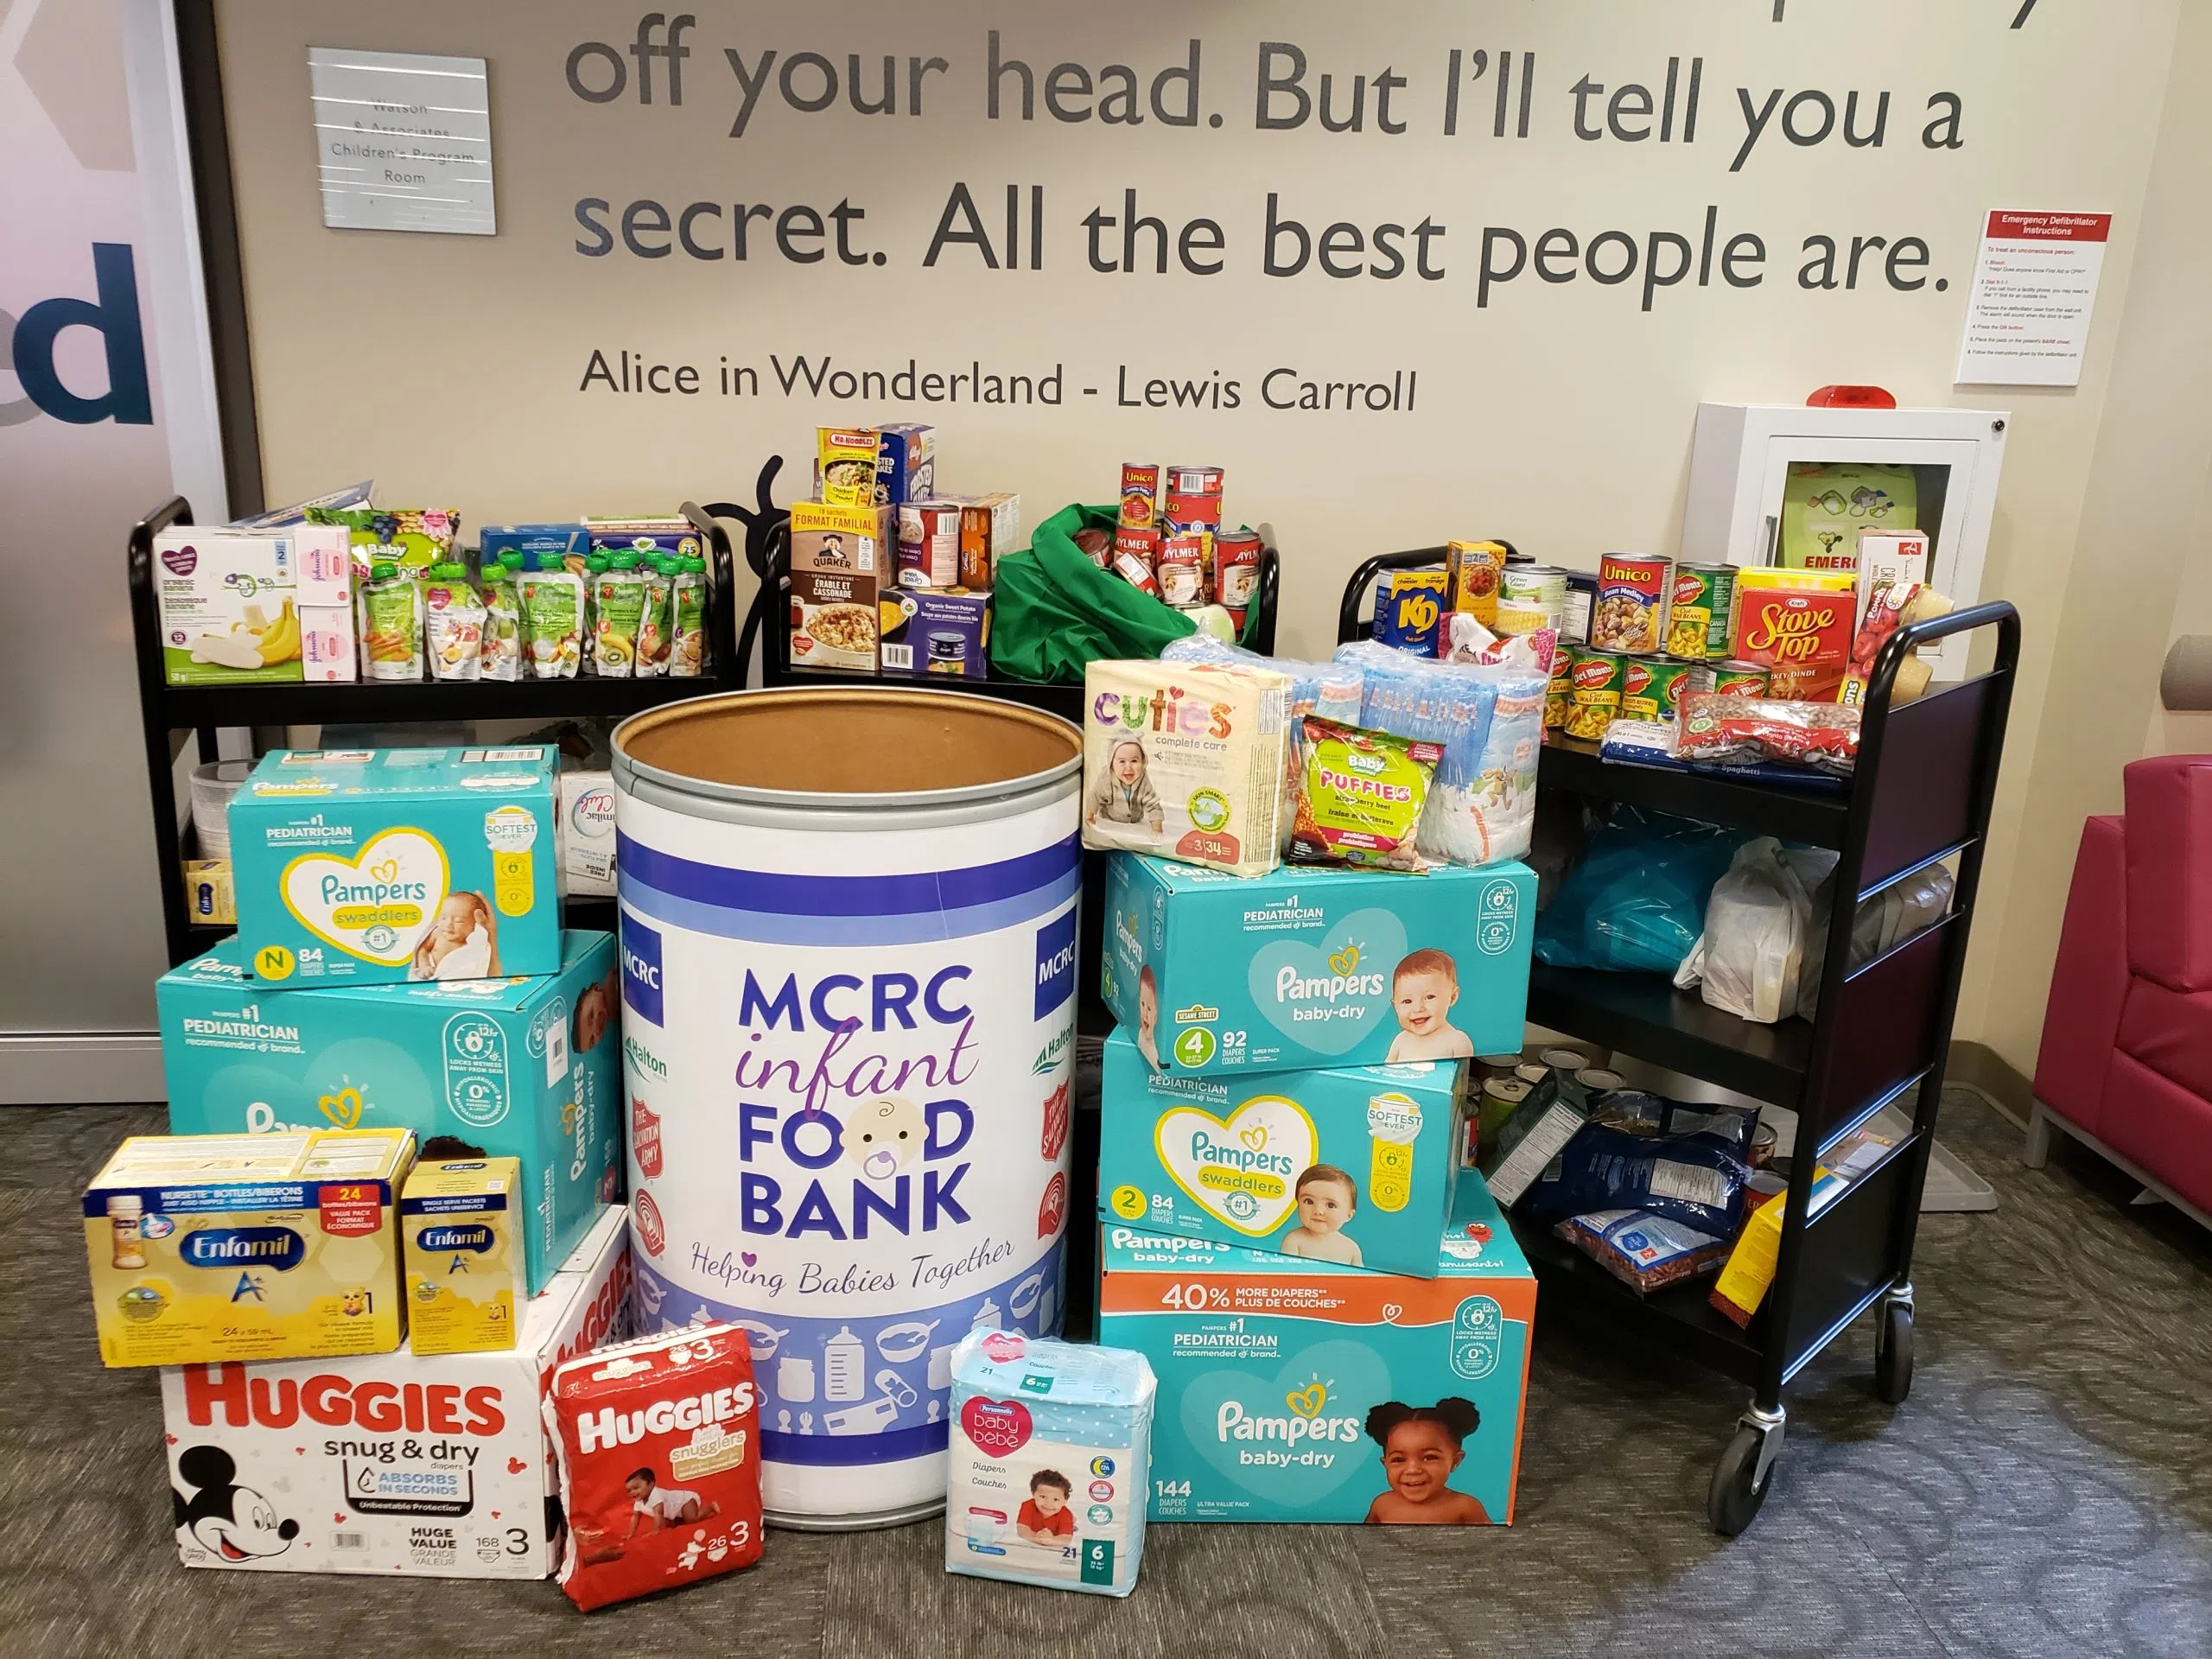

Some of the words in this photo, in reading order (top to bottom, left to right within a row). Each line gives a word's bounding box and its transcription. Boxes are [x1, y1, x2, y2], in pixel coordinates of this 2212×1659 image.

[565, 13, 696, 107] off
[723, 48, 950, 138] your
[987, 29, 1224, 129] head.
[1256, 41, 1408, 135] But
[1444, 48, 1535, 138] I'll
[1568, 57, 1702, 144] tell
[1729, 87, 1890, 172] you
[1923, 91, 1964, 149] a
[332, 143, 406, 159] Children's
[412, 148, 475, 166] Program
[385, 169, 426, 184] Room
[2001, 214, 2049, 226] Emergency
[2050, 216, 2098, 226] Defibrillator
[2023, 226, 2072, 236] Instructions
[574, 195, 887, 267] secret.
[922, 182, 1044, 270] All
[1080, 188, 1226, 276] the
[1263, 193, 1446, 281] best
[1478, 206, 1766, 311] people
[1798, 232, 1949, 292] are.
[579, 349, 700, 395] Alice
[720, 357, 759, 397] in
[770, 355, 1062, 406] Wonderland
[1117, 365, 1242, 410] Lewis
[1261, 367, 1418, 412] Carroll
[846, 436, 873, 445] NOODLES
[1127, 473, 1154, 483] Unico
[795, 514, 830, 526] FORMAT
[833, 518, 873, 530] FAMILIAL
[367, 543, 408, 556] Baby
[1116, 537, 1149, 550] AYLMER
[1162, 547, 1199, 560] AYLMER
[813, 557, 851, 569] QUAKER
[1605, 564, 1651, 582] Unico
[815, 579, 840, 588] ÉRABLE
[813, 588, 852, 598] CASSONADE
[1605, 587, 1619, 598] Bean
[1620, 588, 1644, 602] Medley
[1398, 594, 1439, 634] KD
[1746, 603, 1836, 649] Stove
[1398, 646, 1430, 656] ORIGINAL
[1772, 634, 1820, 663] Top
[1574, 673, 1585, 683] Del
[1586, 665, 1613, 677] Monte
[1628, 672, 1649, 683] Monte
[1094, 686, 1234, 739] cuties
[1155, 736, 1200, 748] complete
[1203, 741, 1227, 751] care
[1348, 755, 1386, 772] Baby
[1721, 764, 1760, 776] Spaghetti
[1320, 769, 1412, 803] PUFFIES
[1328, 809, 1349, 817] fraise
[266, 827, 353, 837] PEDIATRICIAN
[486, 823, 536, 834] SOFTEST
[1342, 831, 1374, 842] probiotics
[1205, 840, 1221, 855] 34
[321, 874, 426, 906] Pampers
[1287, 894, 1299, 907] #1
[336, 908, 418, 924] swaddlers
[1243, 906, 1324, 922] PEDIATRICIAN
[1243, 921, 1292, 931] recommended
[265, 950, 283, 969] N
[298, 948, 323, 962] 84
[1039, 940, 1075, 984] MCRC
[623, 944, 659, 990] MCRC
[1276, 966, 1383, 1003] Pampers
[738, 964, 973, 1033] MCRC
[1198, 1010, 1216, 1019] STREET
[1294, 1005, 1365, 1022] baby-dry
[183, 1018, 300, 1041] PEDIATRICIAN
[185, 1038, 256, 1052] recommended
[1185, 1032, 1204, 1053] 4
[1223, 1031, 1247, 1048] 92
[632, 1037, 667, 1077] Halton
[1222, 1048, 1245, 1057] DIAPERS
[735, 1016, 979, 1122] infant
[1148, 1075, 1228, 1096] PEDIATRICIAN
[1148, 1087, 1196, 1100] recommended
[571, 1061, 584, 1182] Pampers
[635, 1108, 646, 1127] THE
[1369, 1109, 1421, 1126] SOFTEST
[1385, 1122, 1405, 1130] EVER
[641, 1144, 658, 1167] ARMY
[1192, 1131, 1292, 1175] Pampers
[1202, 1172, 1282, 1195] swaddlers
[213, 1186, 303, 1198] BOTTLES/BIBERONS
[340, 1188, 361, 1201] 24
[741, 1163, 972, 1241] BANK
[1122, 1190, 1136, 1208] 2
[1152, 1194, 1173, 1210] 84
[1235, 1199, 1249, 1211] #1
[327, 1221, 375, 1230] ÉCONOMIQUE
[425, 1230, 486, 1245] Enfamil
[1112, 1229, 1230, 1253] Pampers
[194, 1236, 290, 1258] Enfamil
[1134, 1253, 1214, 1264] baby-dry
[691, 1242, 785, 1297] Helping
[798, 1262, 899, 1295] Babies
[912, 1237, 1016, 1288] Together
[1161, 1283, 1230, 1310] 40%
[1236, 1287, 1268, 1297] MORE
[1235, 1298, 1262, 1307] PLUS
[1266, 1299, 1281, 1307] DE
[1229, 1318, 1244, 1333] #1
[1174, 1333, 1278, 1347] PEDIATRICIAN
[693, 1338, 715, 1360] 3
[1173, 1350, 1236, 1358] recommended
[980, 1366, 994, 1376] 21
[183, 1363, 505, 1436] HUGGIES
[982, 1404, 1014, 1414] Personnelle
[577, 1382, 754, 1454] HUGGIES
[974, 1414, 1019, 1433] baby
[1218, 1401, 1358, 1447] Pampers
[973, 1430, 1019, 1448] bébé
[325, 1440, 397, 1463] snug
[402, 1440, 423, 1459] &
[430, 1440, 480, 1466] dry
[672, 1433, 744, 1461] snugglers
[431, 1461, 464, 1471] diapers
[1240, 1449, 1335, 1469] baby-dry
[972, 1461, 1007, 1474] Diapers
[378, 1472, 458, 1485] ABSORBS
[972, 1476, 1007, 1490] Couches
[378, 1484, 393, 1494] IN
[395, 1484, 458, 1496] SECONDS
[1156, 1480, 1192, 1497] 144
[359, 1502, 411, 1512] Unbeatable
[412, 1503, 461, 1513] Protection
[1159, 1507, 1186, 1516] COUCHES
[411, 1527, 454, 1538] HUGE
[708, 1535, 727, 1551] 26
[730, 1521, 749, 1547] 3
[409, 1539, 457, 1549] VALUE
[476, 1536, 499, 1548] 168
[505, 1528, 530, 1555] 3
[410, 1548, 456, 1558] GRANDE
[1062, 1547, 1077, 1559] 21
[1091, 1545, 1104, 1560] 6
[412, 1557, 456, 1567] VALEUR
